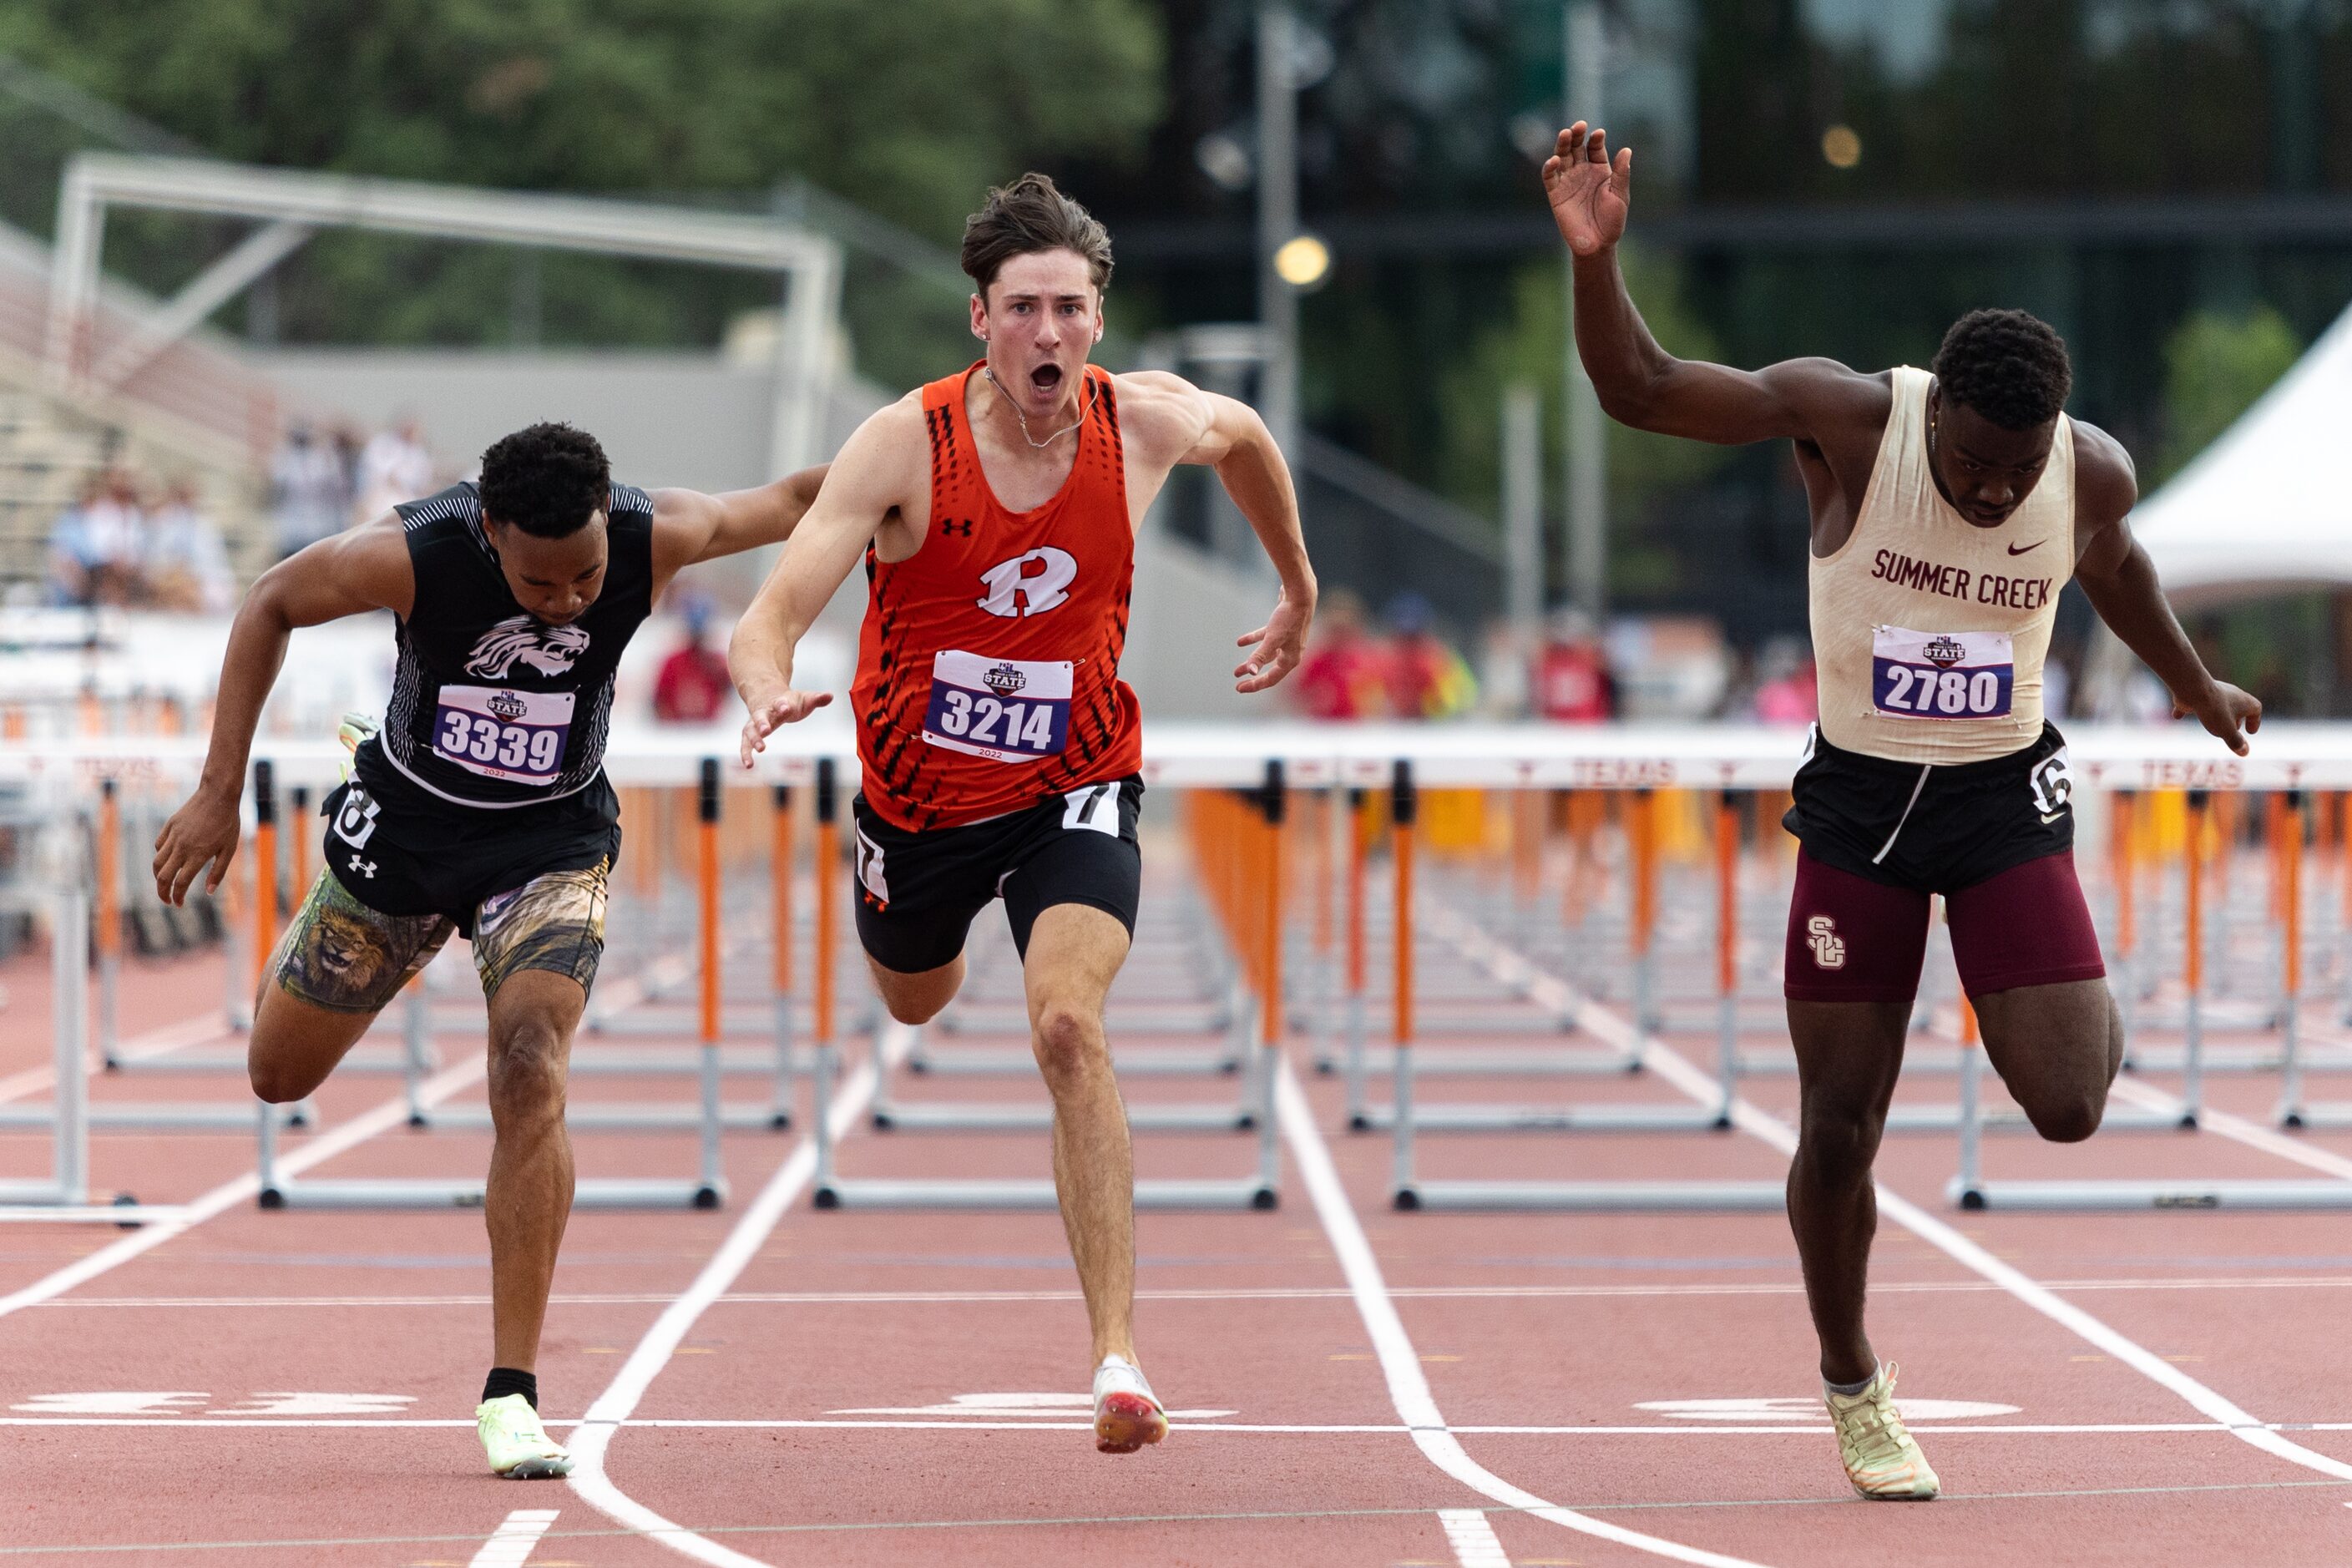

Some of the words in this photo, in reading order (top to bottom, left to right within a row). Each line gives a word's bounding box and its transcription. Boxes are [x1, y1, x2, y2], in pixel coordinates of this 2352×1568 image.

[975, 545, 1078, 618] R
[1871, 549, 1970, 600] SUMMER
[1976, 574, 2053, 610] CREEK
[1924, 648, 1965, 659] STATE
[984, 673, 1026, 688] STATE
[1884, 665, 1999, 714] 2780
[488, 700, 527, 716] STATE
[940, 690, 1054, 751] 3214
[441, 711, 559, 772] 3339
[979, 748, 1003, 759] 2022
[483, 767, 506, 778] 2022
[1572, 756, 1677, 787] TEXAS
[2036, 757, 2071, 811] 6
[2142, 758, 2244, 789] TEXAS
[1806, 914, 1845, 969] SC
